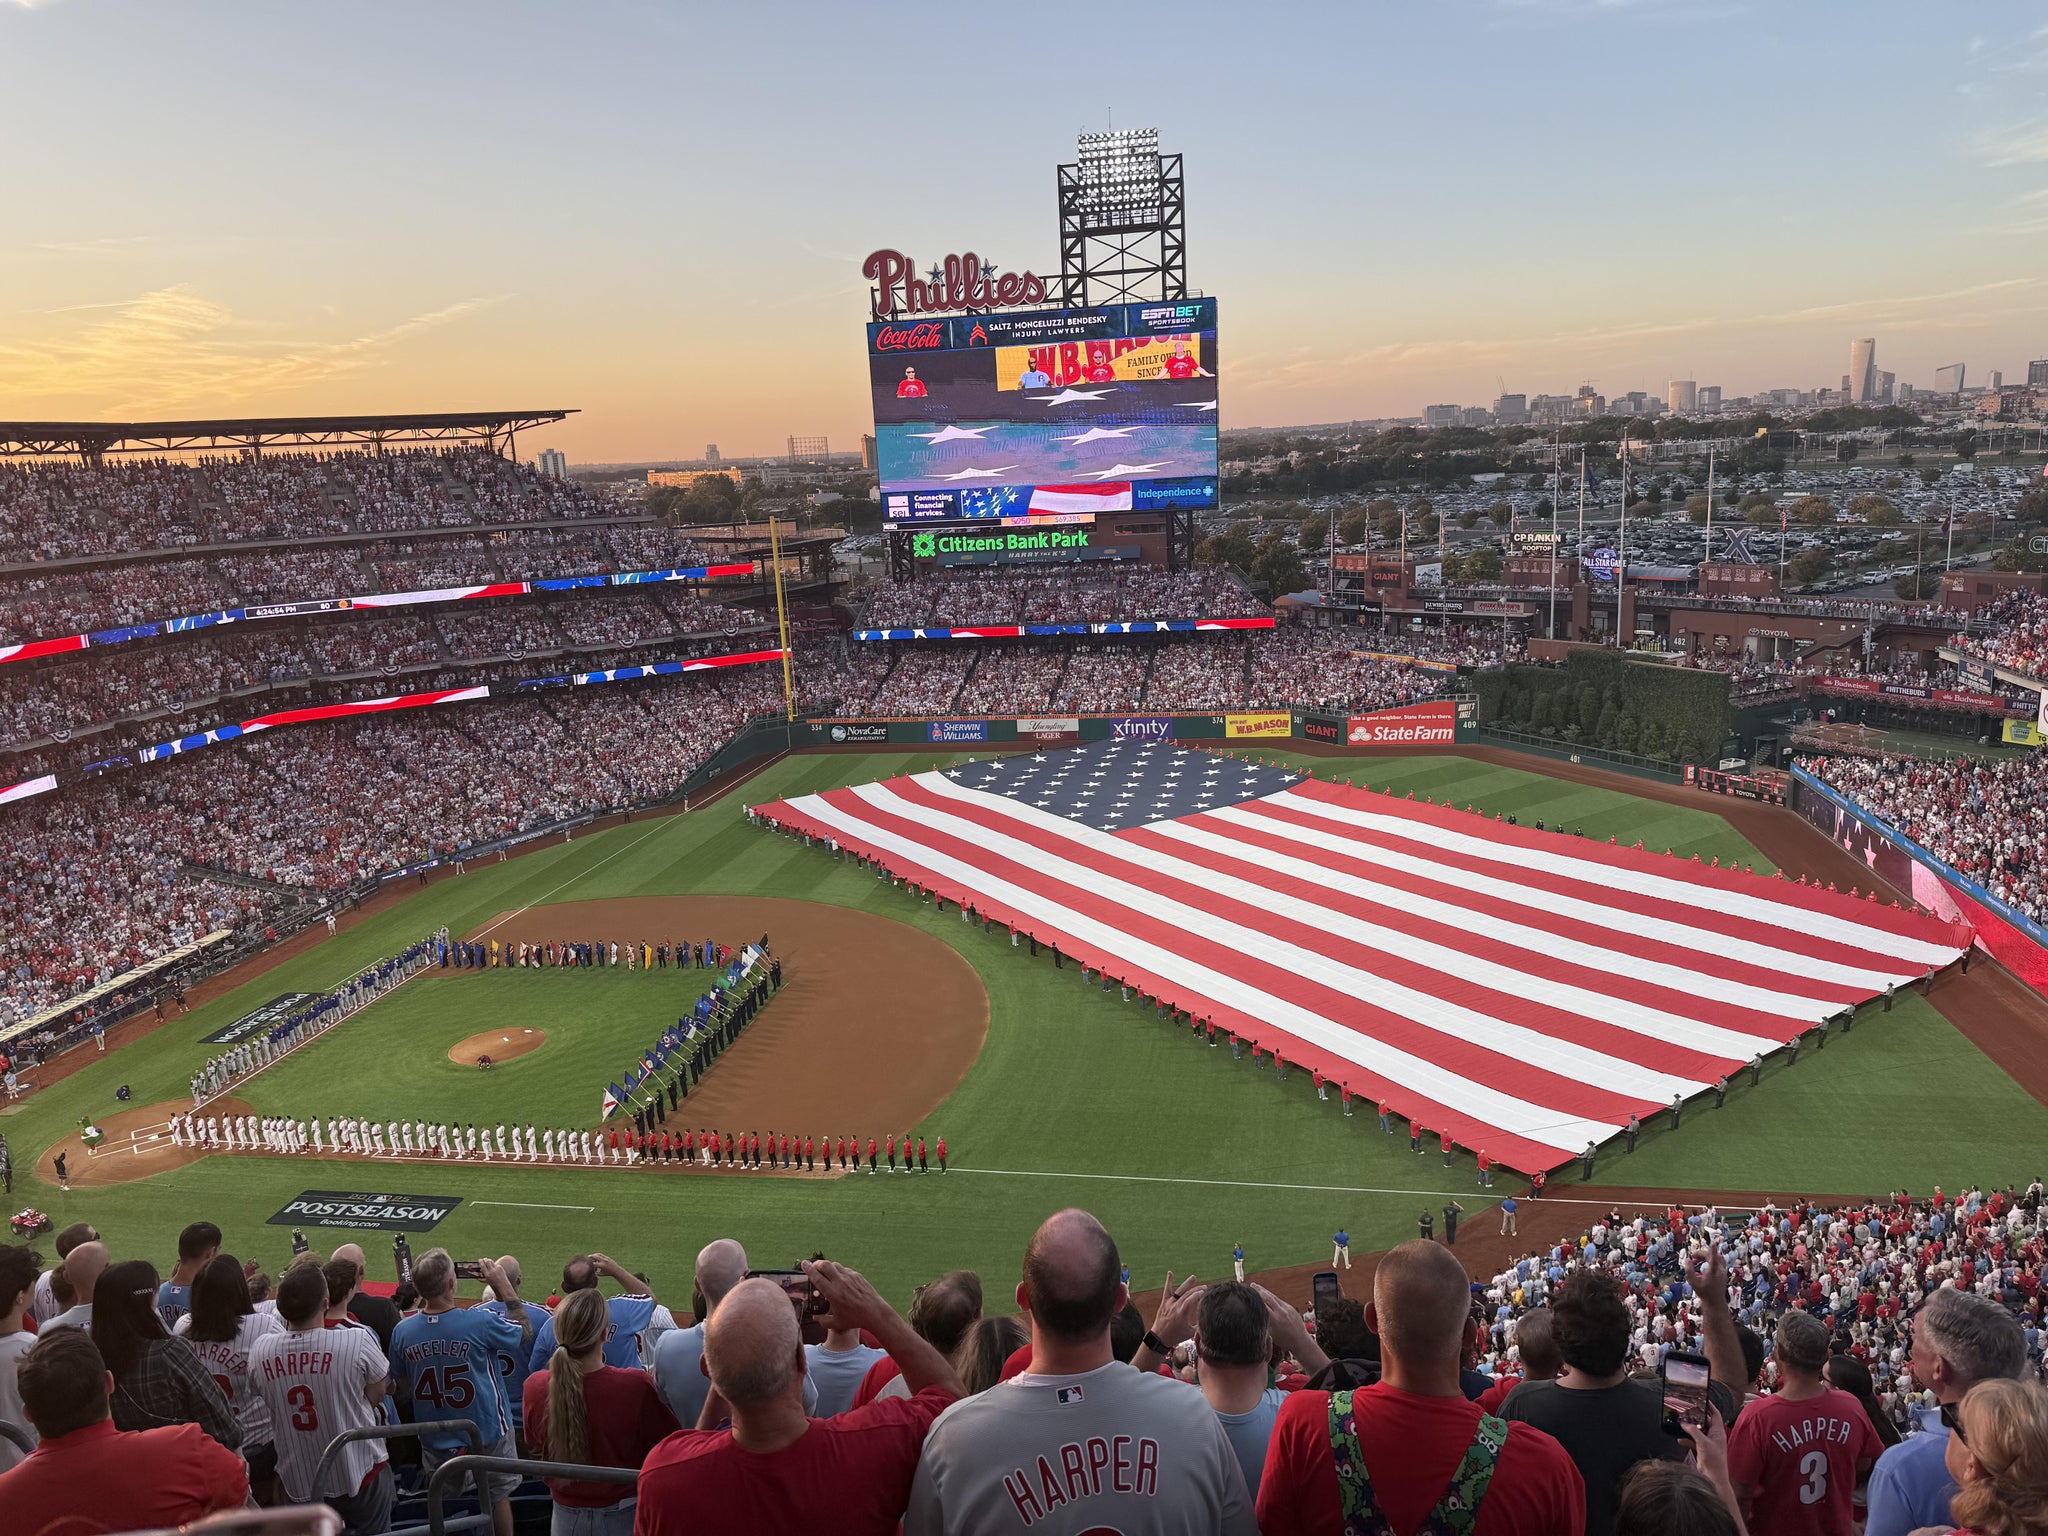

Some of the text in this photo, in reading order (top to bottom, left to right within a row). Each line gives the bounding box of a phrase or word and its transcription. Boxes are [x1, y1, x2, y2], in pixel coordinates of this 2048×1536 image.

[863, 249, 1046, 315] Phillies
[1141, 305, 1203, 320] ESPN BET
[989, 316, 1107, 331] SALTZ MONGELUZZI BENDESKY
[1148, 317, 1195, 326] SPORTSBOOK
[1012, 327, 1085, 338] INJURY LAWYERS
[1127, 354, 1159, 368] FAMILY
[914, 493, 953, 502] Connecting
[1137, 488, 1201, 499] Independence
[915, 501, 944, 509] financial
[915, 509, 945, 517] services.
[939, 529, 1088, 553] Citizens Bank Park
[1513, 533, 1526, 542] CP
[1373, 573, 1399, 581] GIANT
[256, 608, 284, 616] 6:24:54
[1760, 629, 1789, 637] TOYOTA
[1673, 638, 1686, 646] 482
[1834, 679, 1869, 690] Budweiser
[1886, 685, 1925, 697] #HITTHEBUDS
[1955, 694, 1994, 706] Budweiser
[944, 722, 981, 732] SHERWIN
[1028, 720, 1067, 731] Yuengling
[1113, 719, 1168, 736] xfinity
[1463, 720, 1477, 729] 409
[847, 726, 887, 736] NovaCare
[1305, 724, 1338, 738] GIANT
[1569, 754, 1581, 764] 401
[1736, 789, 1757, 799] TOYOTA
[283, 1201, 448, 1221] POSTSEASON
[319, 1218, 380, 1228] Booking.com
[405, 1339, 470, 1363] WHEELER
[262, 1351, 333, 1382] HARPER
[415, 1363, 476, 1409] 45
[287, 1384, 319, 1432] 3
[1772, 1416, 1851, 1454] HARPER
[1002, 1434, 1159, 1527] HARPER
[1799, 1450, 1828, 1505] 3
